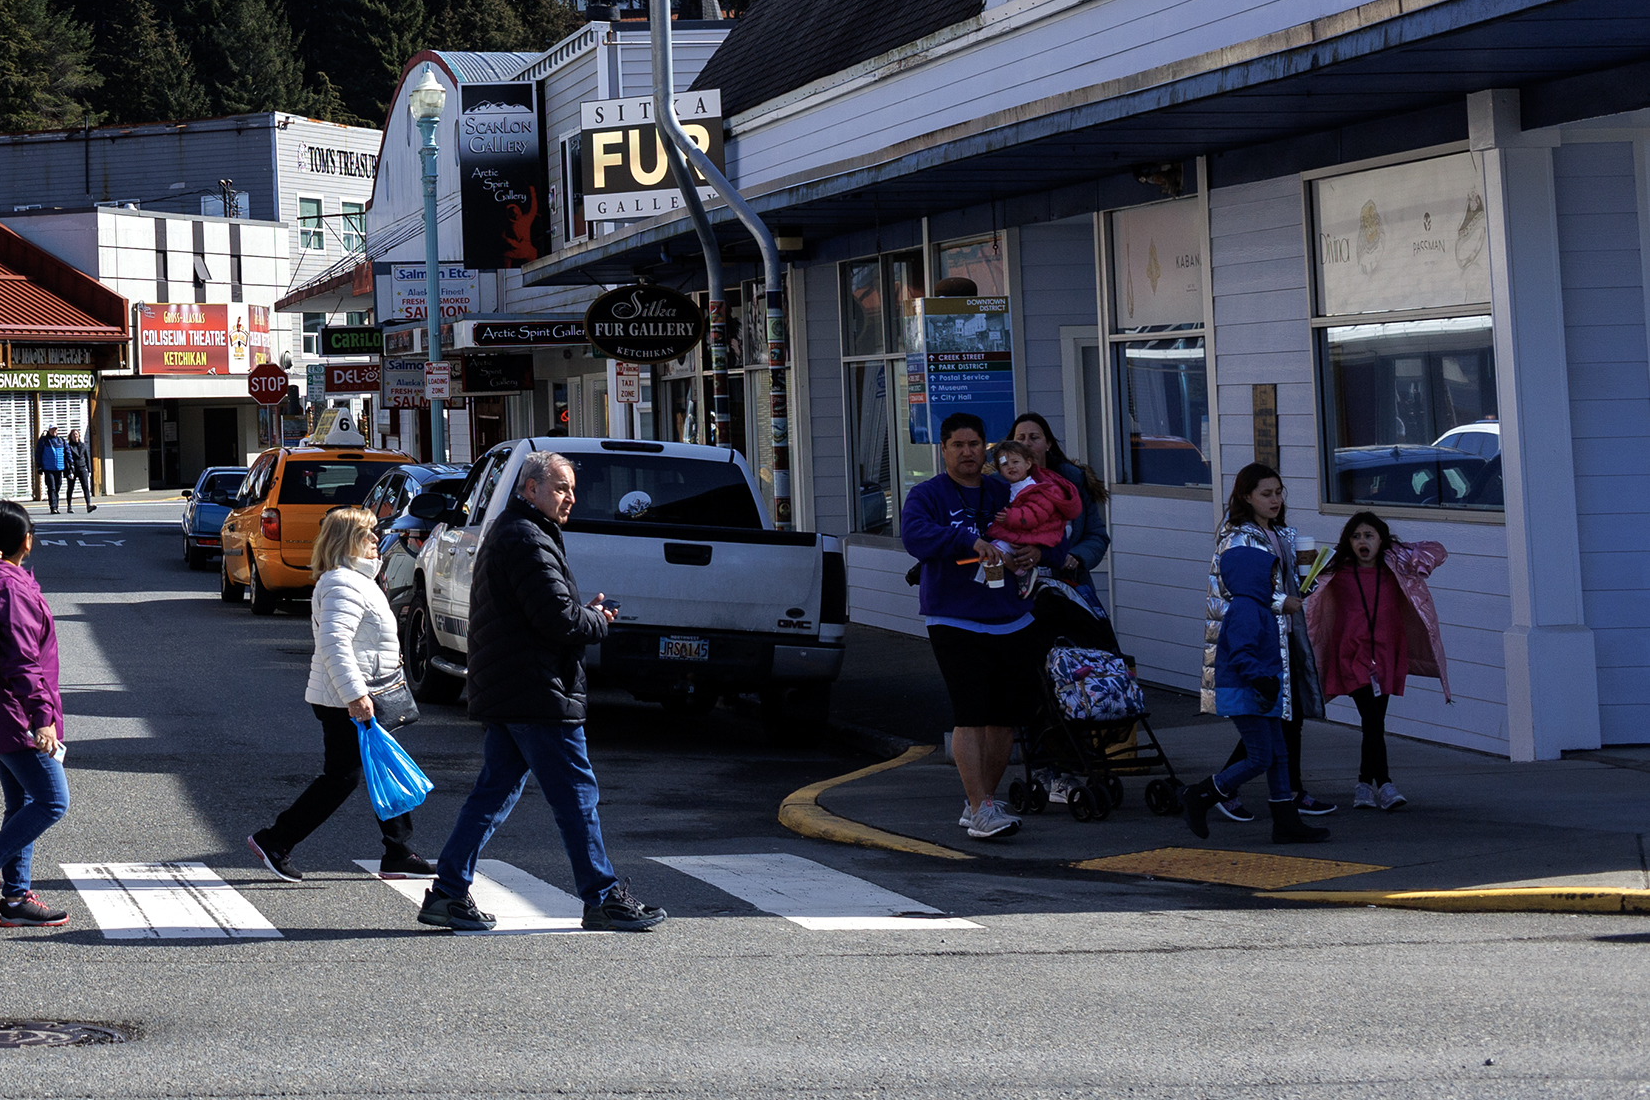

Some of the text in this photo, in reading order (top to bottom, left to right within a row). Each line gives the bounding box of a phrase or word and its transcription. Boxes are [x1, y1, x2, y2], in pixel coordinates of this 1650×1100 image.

[471, 167, 499, 178] Arctic
[483, 178, 509, 192] Spirit
[494, 190, 527, 203] Gallery
[1412, 239, 1446, 256] PASSMAN
[399, 268, 471, 279] Salmn Etc.
[482, 325, 588, 341] Arctic Spirit Galler
[595, 322, 695, 336] FUR GALLERY
[142, 330, 187, 346] COLISEUM
[188, 330, 227, 346] THEATRE
[164, 352, 207, 366] KETCHIKAN
[616, 346, 674, 358] KETCHIKAN
[47, 373, 95, 388] ESPRESSO
[962, 373, 990, 381] Service
[251, 377, 286, 392] STOP
[393, 396, 453, 407] SALMN
[339, 418, 350, 432] 6
[40, 539, 127, 548] NLY
[778, 619, 812, 630] GMC
[660, 642, 708, 657] JRS 145
